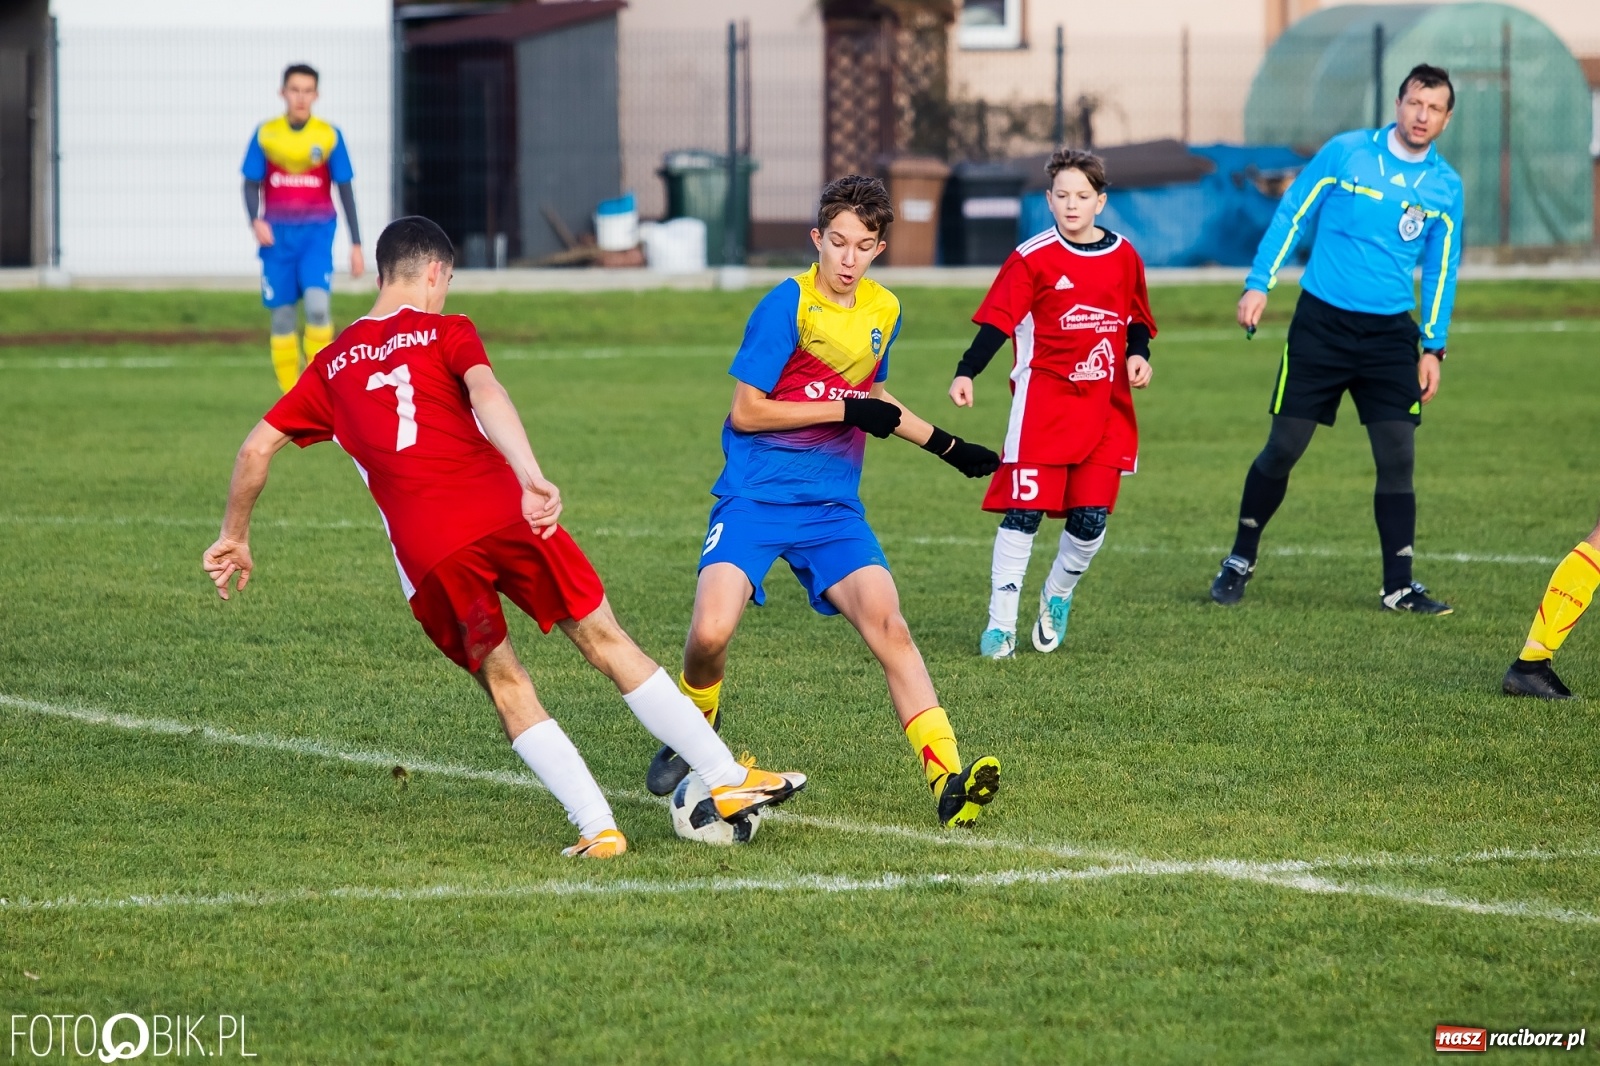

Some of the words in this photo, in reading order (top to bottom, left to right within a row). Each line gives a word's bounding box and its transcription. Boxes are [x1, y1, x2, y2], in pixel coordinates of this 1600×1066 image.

[326, 351, 347, 380] LKS
[349, 328, 438, 364] STUDZIENNA
[1012, 468, 1039, 500] 15
[702, 522, 724, 557] 9
